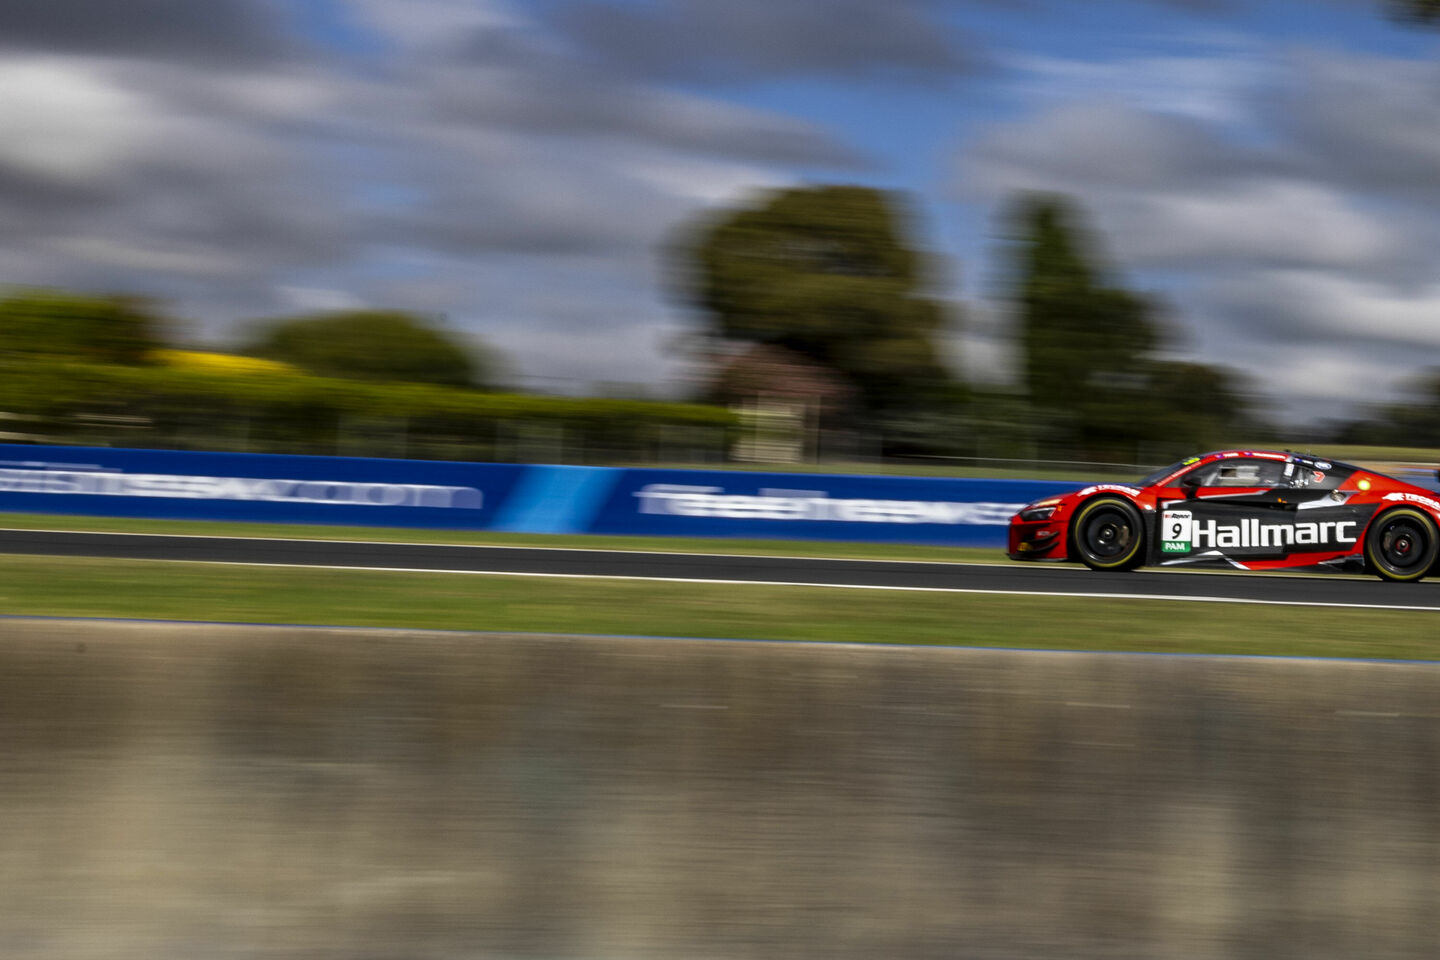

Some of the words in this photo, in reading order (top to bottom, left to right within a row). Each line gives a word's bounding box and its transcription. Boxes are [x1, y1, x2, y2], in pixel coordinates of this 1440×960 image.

[1172, 522, 1183, 540] 9
[1191, 518, 1357, 548] Hallmarc
[1164, 542, 1186, 551] PAM
